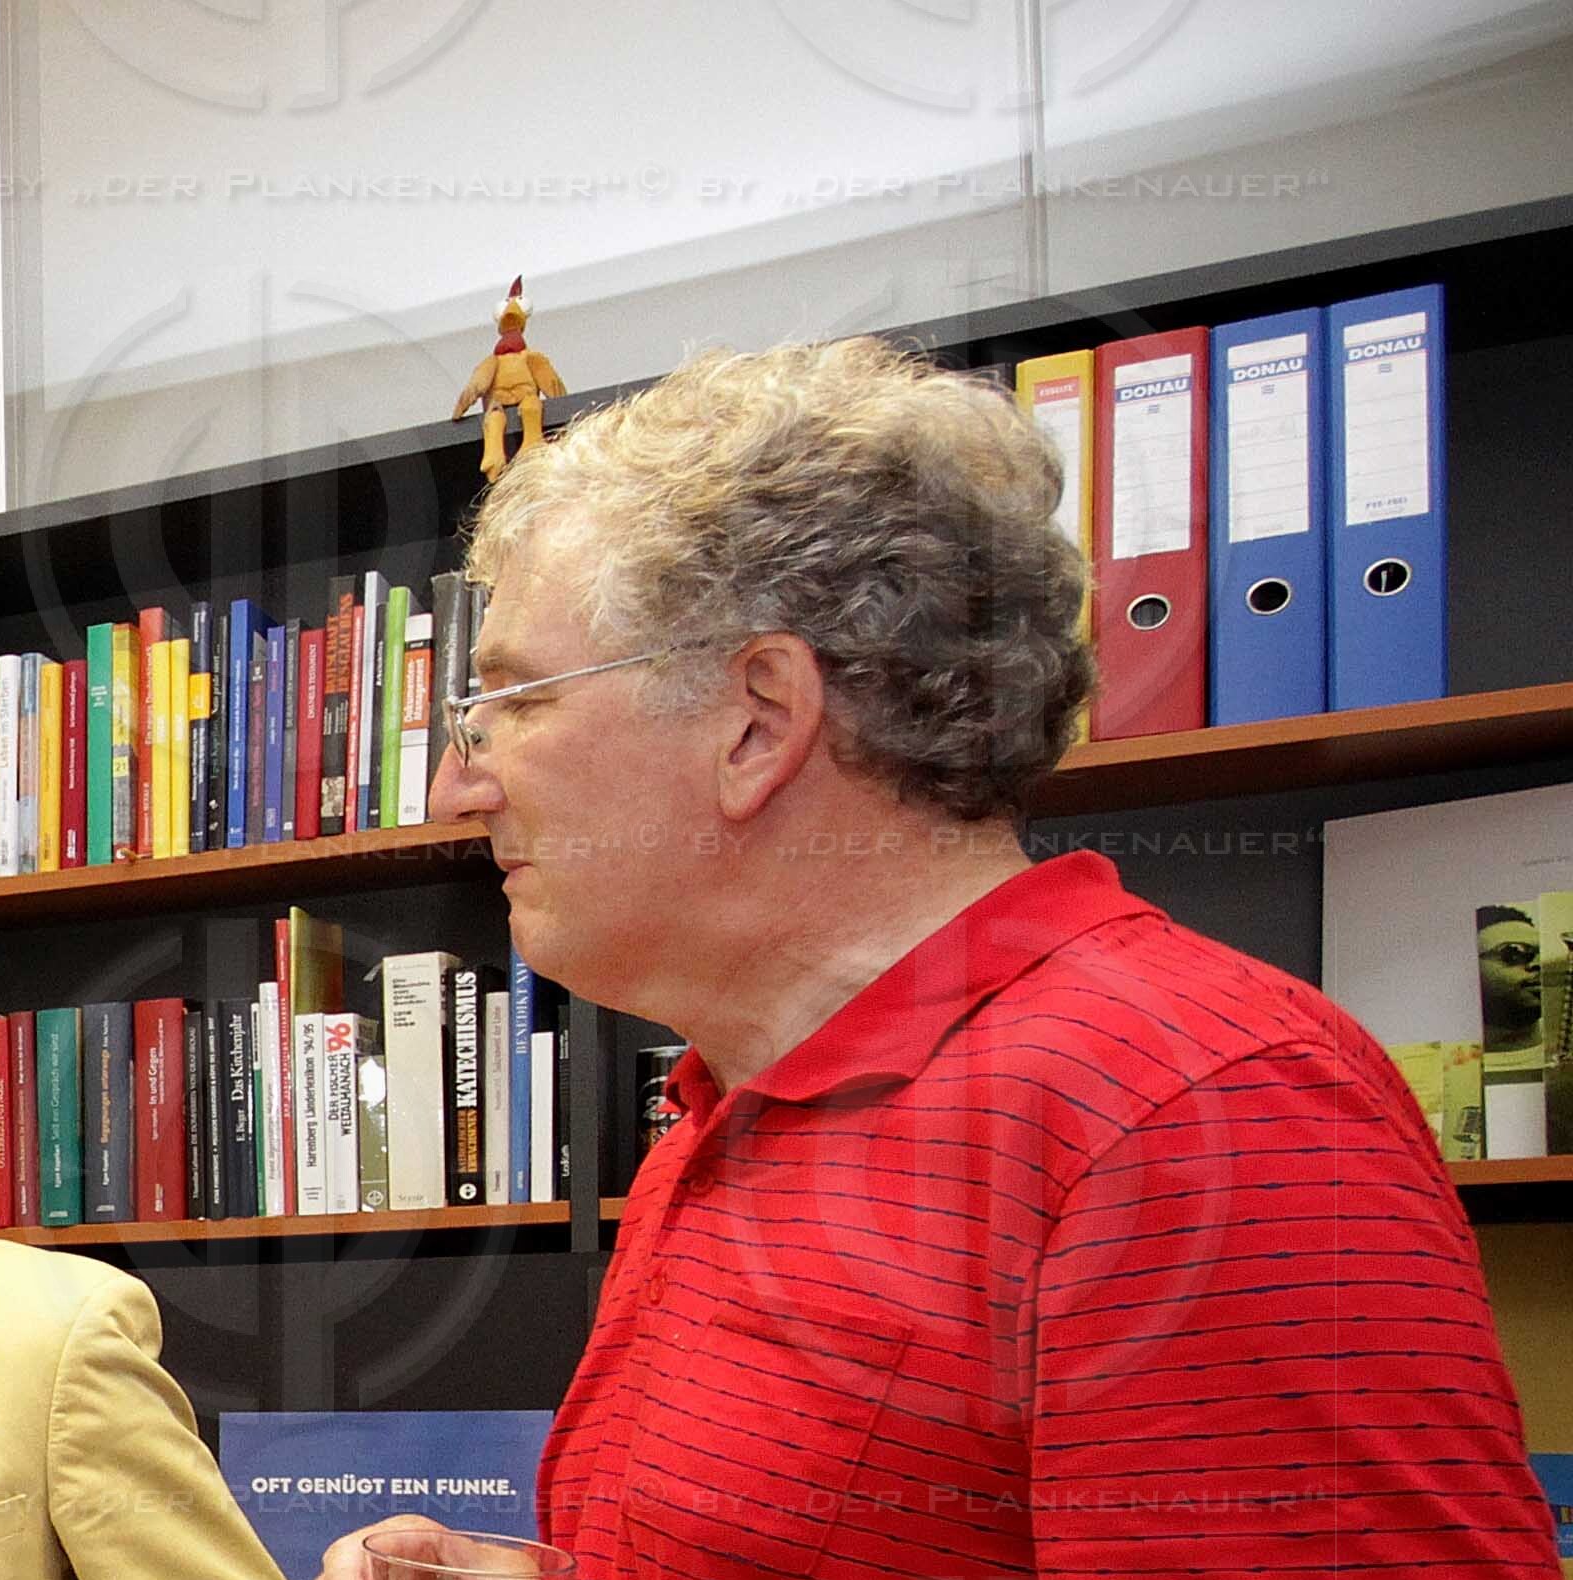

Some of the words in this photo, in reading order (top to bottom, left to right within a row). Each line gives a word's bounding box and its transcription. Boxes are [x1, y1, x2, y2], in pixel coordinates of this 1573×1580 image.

[1349, 335, 1423, 360] DONAU
[1233, 356, 1304, 382] DONAU
[1119, 376, 1189, 401] DONAU
[515, 988, 529, 1055] BENEDIKT
[229, 1014, 244, 1077] Kirchenjahr
[455, 972, 478, 1107] KATECHISMUS
[148, 1047, 159, 1076] Gegen
[328, 1054, 338, 1097] FISCHER
[50, 1068, 62, 1107] Gespräch
[148, 1076, 157, 1093] und
[232, 1078, 244, 1101] Das
[304, 1057, 316, 1118] Länderlexikon
[336, 1052, 352, 1137] WELTALMANACH
[149, 1095, 157, 1104] In
[328, 1100, 338, 1121] DER
[305, 1121, 318, 1167] Harenberg
[251, 1476, 292, 1494] OFT
[296, 1473, 386, 1495] GENÜGT
[390, 1477, 430, 1496] EIN
[436, 1478, 517, 1496] FUNKE.
